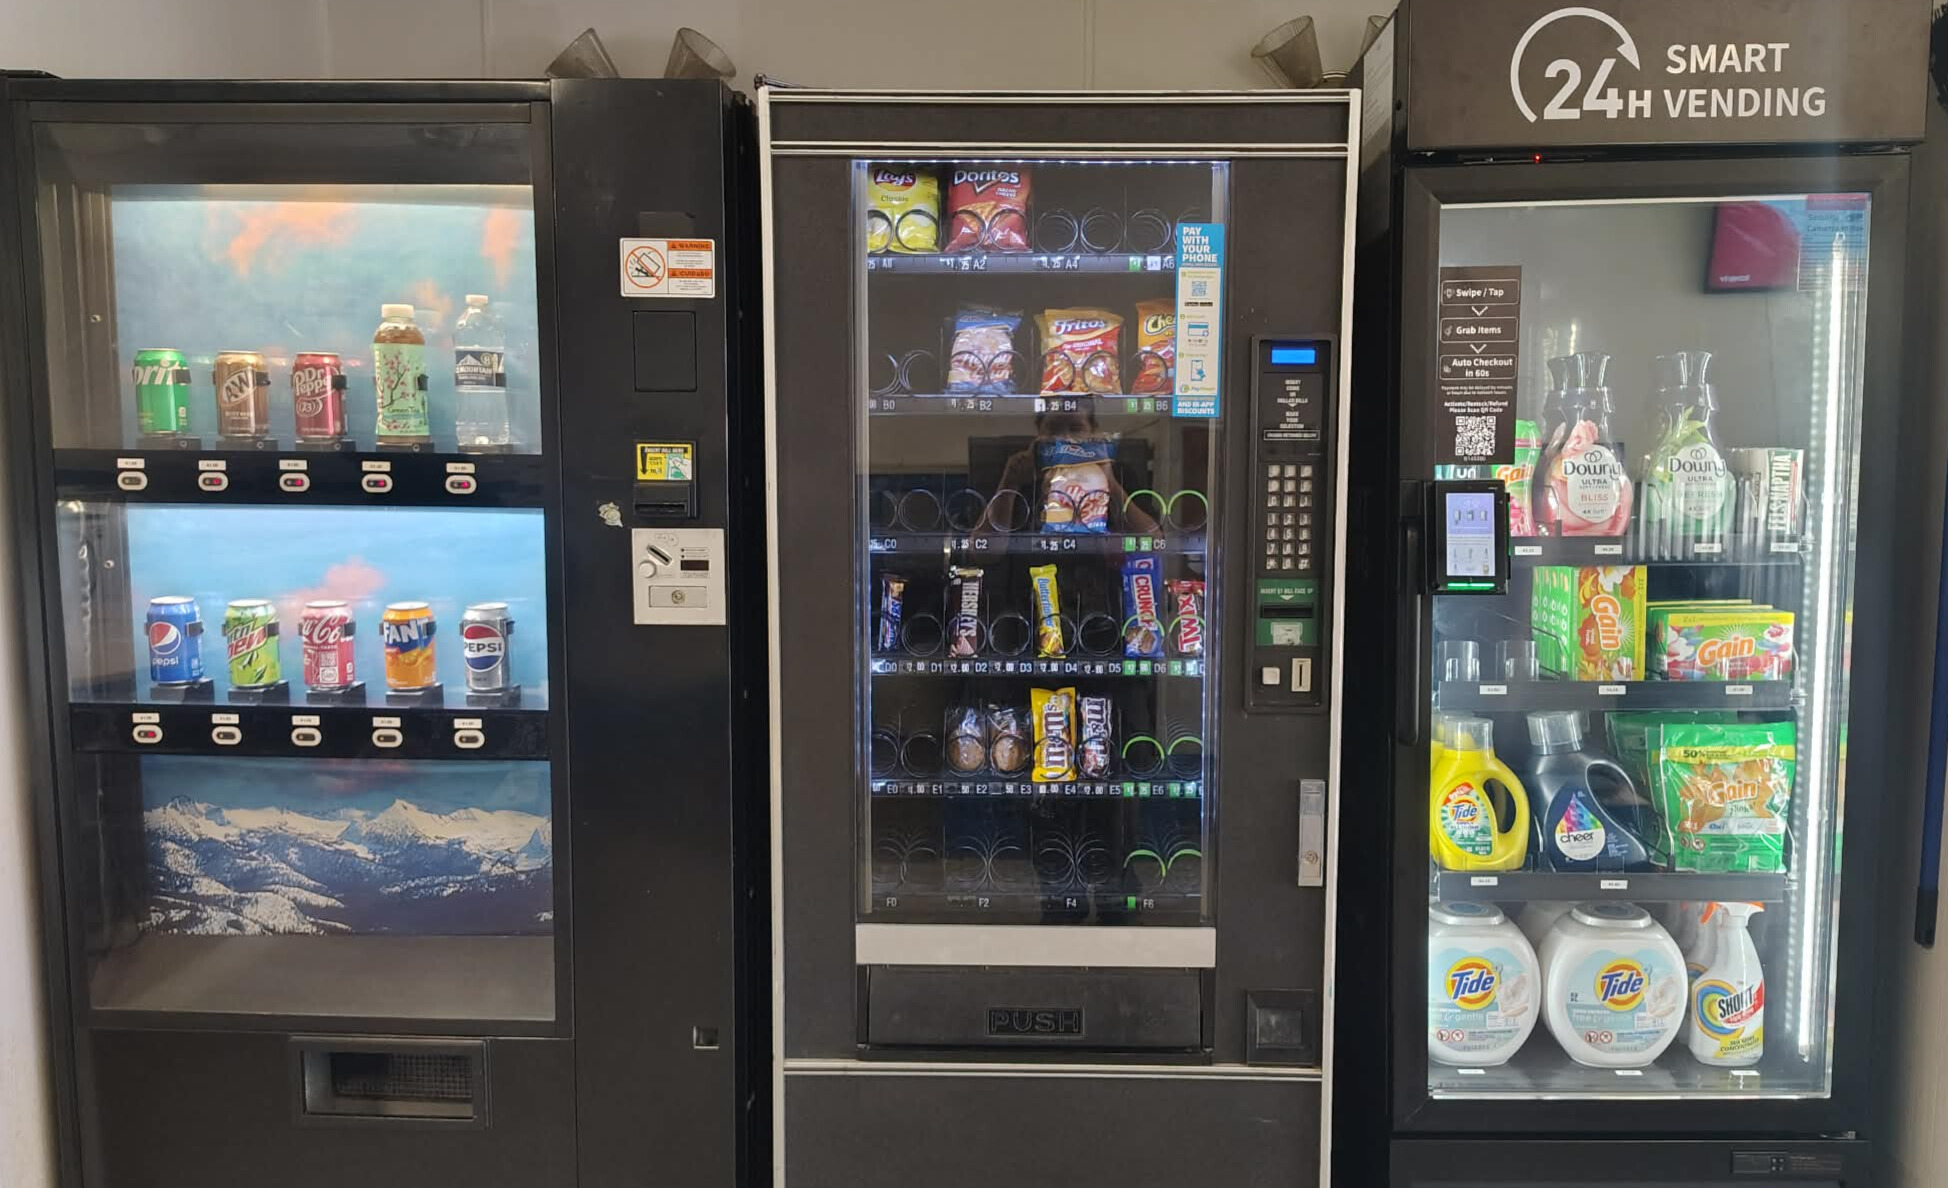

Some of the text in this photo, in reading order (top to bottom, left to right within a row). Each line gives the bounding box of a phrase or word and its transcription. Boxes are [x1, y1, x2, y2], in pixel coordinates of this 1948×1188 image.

[1666, 43, 1789, 74] SMART
[1664, 86, 1826, 119] VENDING
[954, 170, 1019, 185] Doritos
[1183, 227, 1202, 235] PAY
[1183, 236, 1209, 244] WITH
[1182, 245, 1210, 253] YOUR
[1182, 253, 1217, 262] PHONE
[973, 258, 986, 270] A2
[1065, 258, 1078, 270] A4
[1162, 258, 1175, 269] A6
[1456, 288, 1482, 298] Swipe
[1489, 288, 1504, 298] Tap
[1054, 318, 1105, 335] Fritos
[1146, 314, 1176, 334] Che
[1456, 326, 1501, 334] Grab Items
[1473, 358, 1513, 366] Checkout
[134, 359, 188, 386] prit
[304, 367, 325, 381] Dr
[1465, 369, 1473, 377] in
[294, 371, 331, 396] Peppe
[979, 400, 992, 411] B2
[1065, 400, 1077, 411] B4
[1156, 401, 1168, 411] B6
[1564, 461, 1620, 480] Downy
[1670, 459, 1726, 477] Downy
[1581, 494, 1609, 502] BLISS
[884, 539, 897, 549] C0
[975, 539, 988, 549] C2
[1063, 539, 1076, 549] C4
[1153, 539, 1166, 550] C6
[1178, 594, 1202, 653] TWIX
[1592, 595, 1621, 649] Gain
[383, 618, 429, 644] FANT
[464, 642, 502, 653] PEPSI
[1698, 636, 1755, 666] Gain
[152, 656, 179, 666] pepsi
[884, 662, 897, 672] D0
[931, 663, 942, 672] D1
[975, 662, 988, 672] D2
[1020, 663, 1032, 672] D3
[1065, 663, 1078, 673] D4
[1109, 663, 1121, 673] D5
[1154, 664, 1167, 673] D6
[887, 785, 898, 794] E0
[932, 785, 943, 794] E1
[976, 785, 987, 795] E2
[1020, 785, 1032, 795] E3
[1065, 785, 1077, 795] E4
[1109, 785, 1121, 795] E5
[1152, 785, 1164, 795] E6
[1708, 780, 1759, 807] Gain
[1453, 805, 1477, 821] Tide
[1560, 832, 1594, 844] cheer
[979, 898, 989, 908] F2
[1066, 898, 1077, 908] F4
[1452, 970, 1495, 1000] Tide
[1602, 972, 1644, 1001] Tide
[991, 1011, 1079, 1033] PUSH
